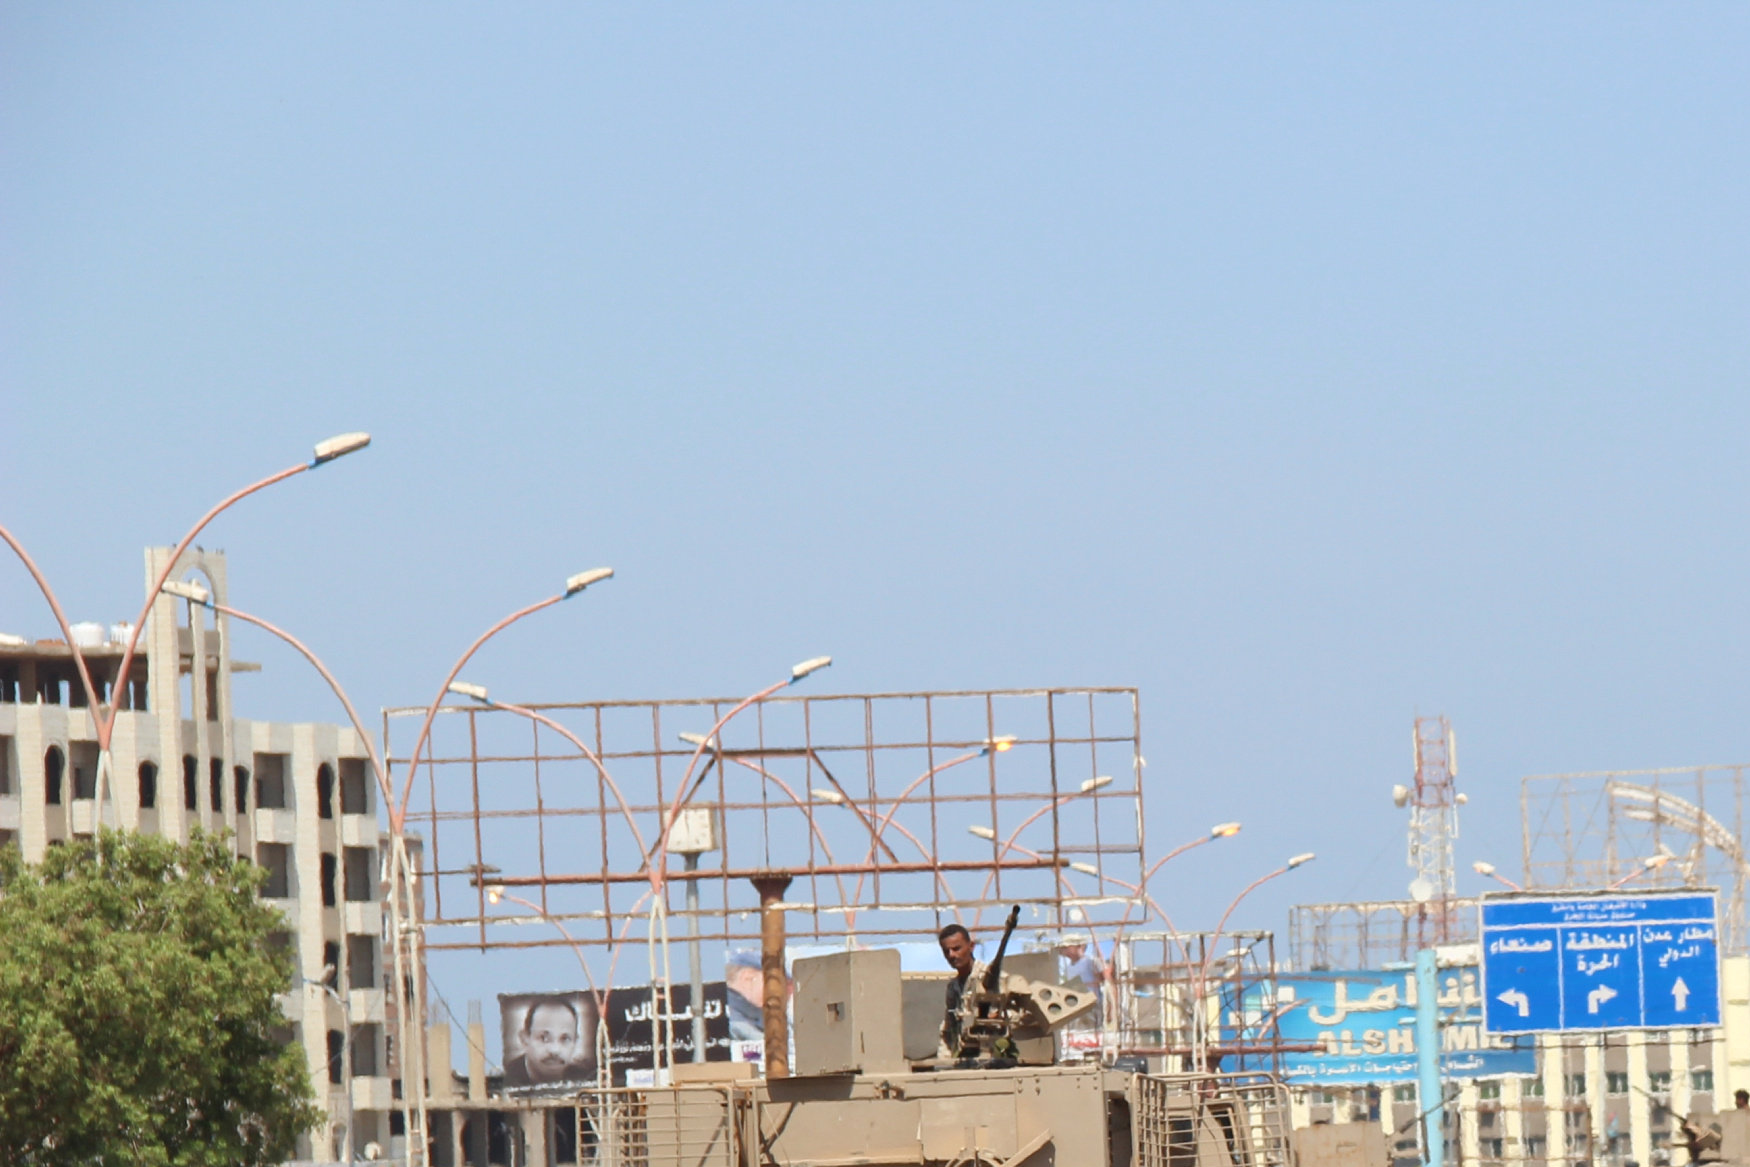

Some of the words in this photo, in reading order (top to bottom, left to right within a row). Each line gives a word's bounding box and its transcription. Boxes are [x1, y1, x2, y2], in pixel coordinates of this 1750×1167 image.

[1566, 932, 1634, 951] المنطقة
[1642, 927, 1673, 943] عدن
[1677, 927, 1713, 945] مطار
[1490, 937, 1553, 954] صنعاء
[1576, 952, 1620, 975] الحرة
[1659, 945, 1700, 967] الدولي
[1313, 1024, 1513, 1056] ALSHMIL
